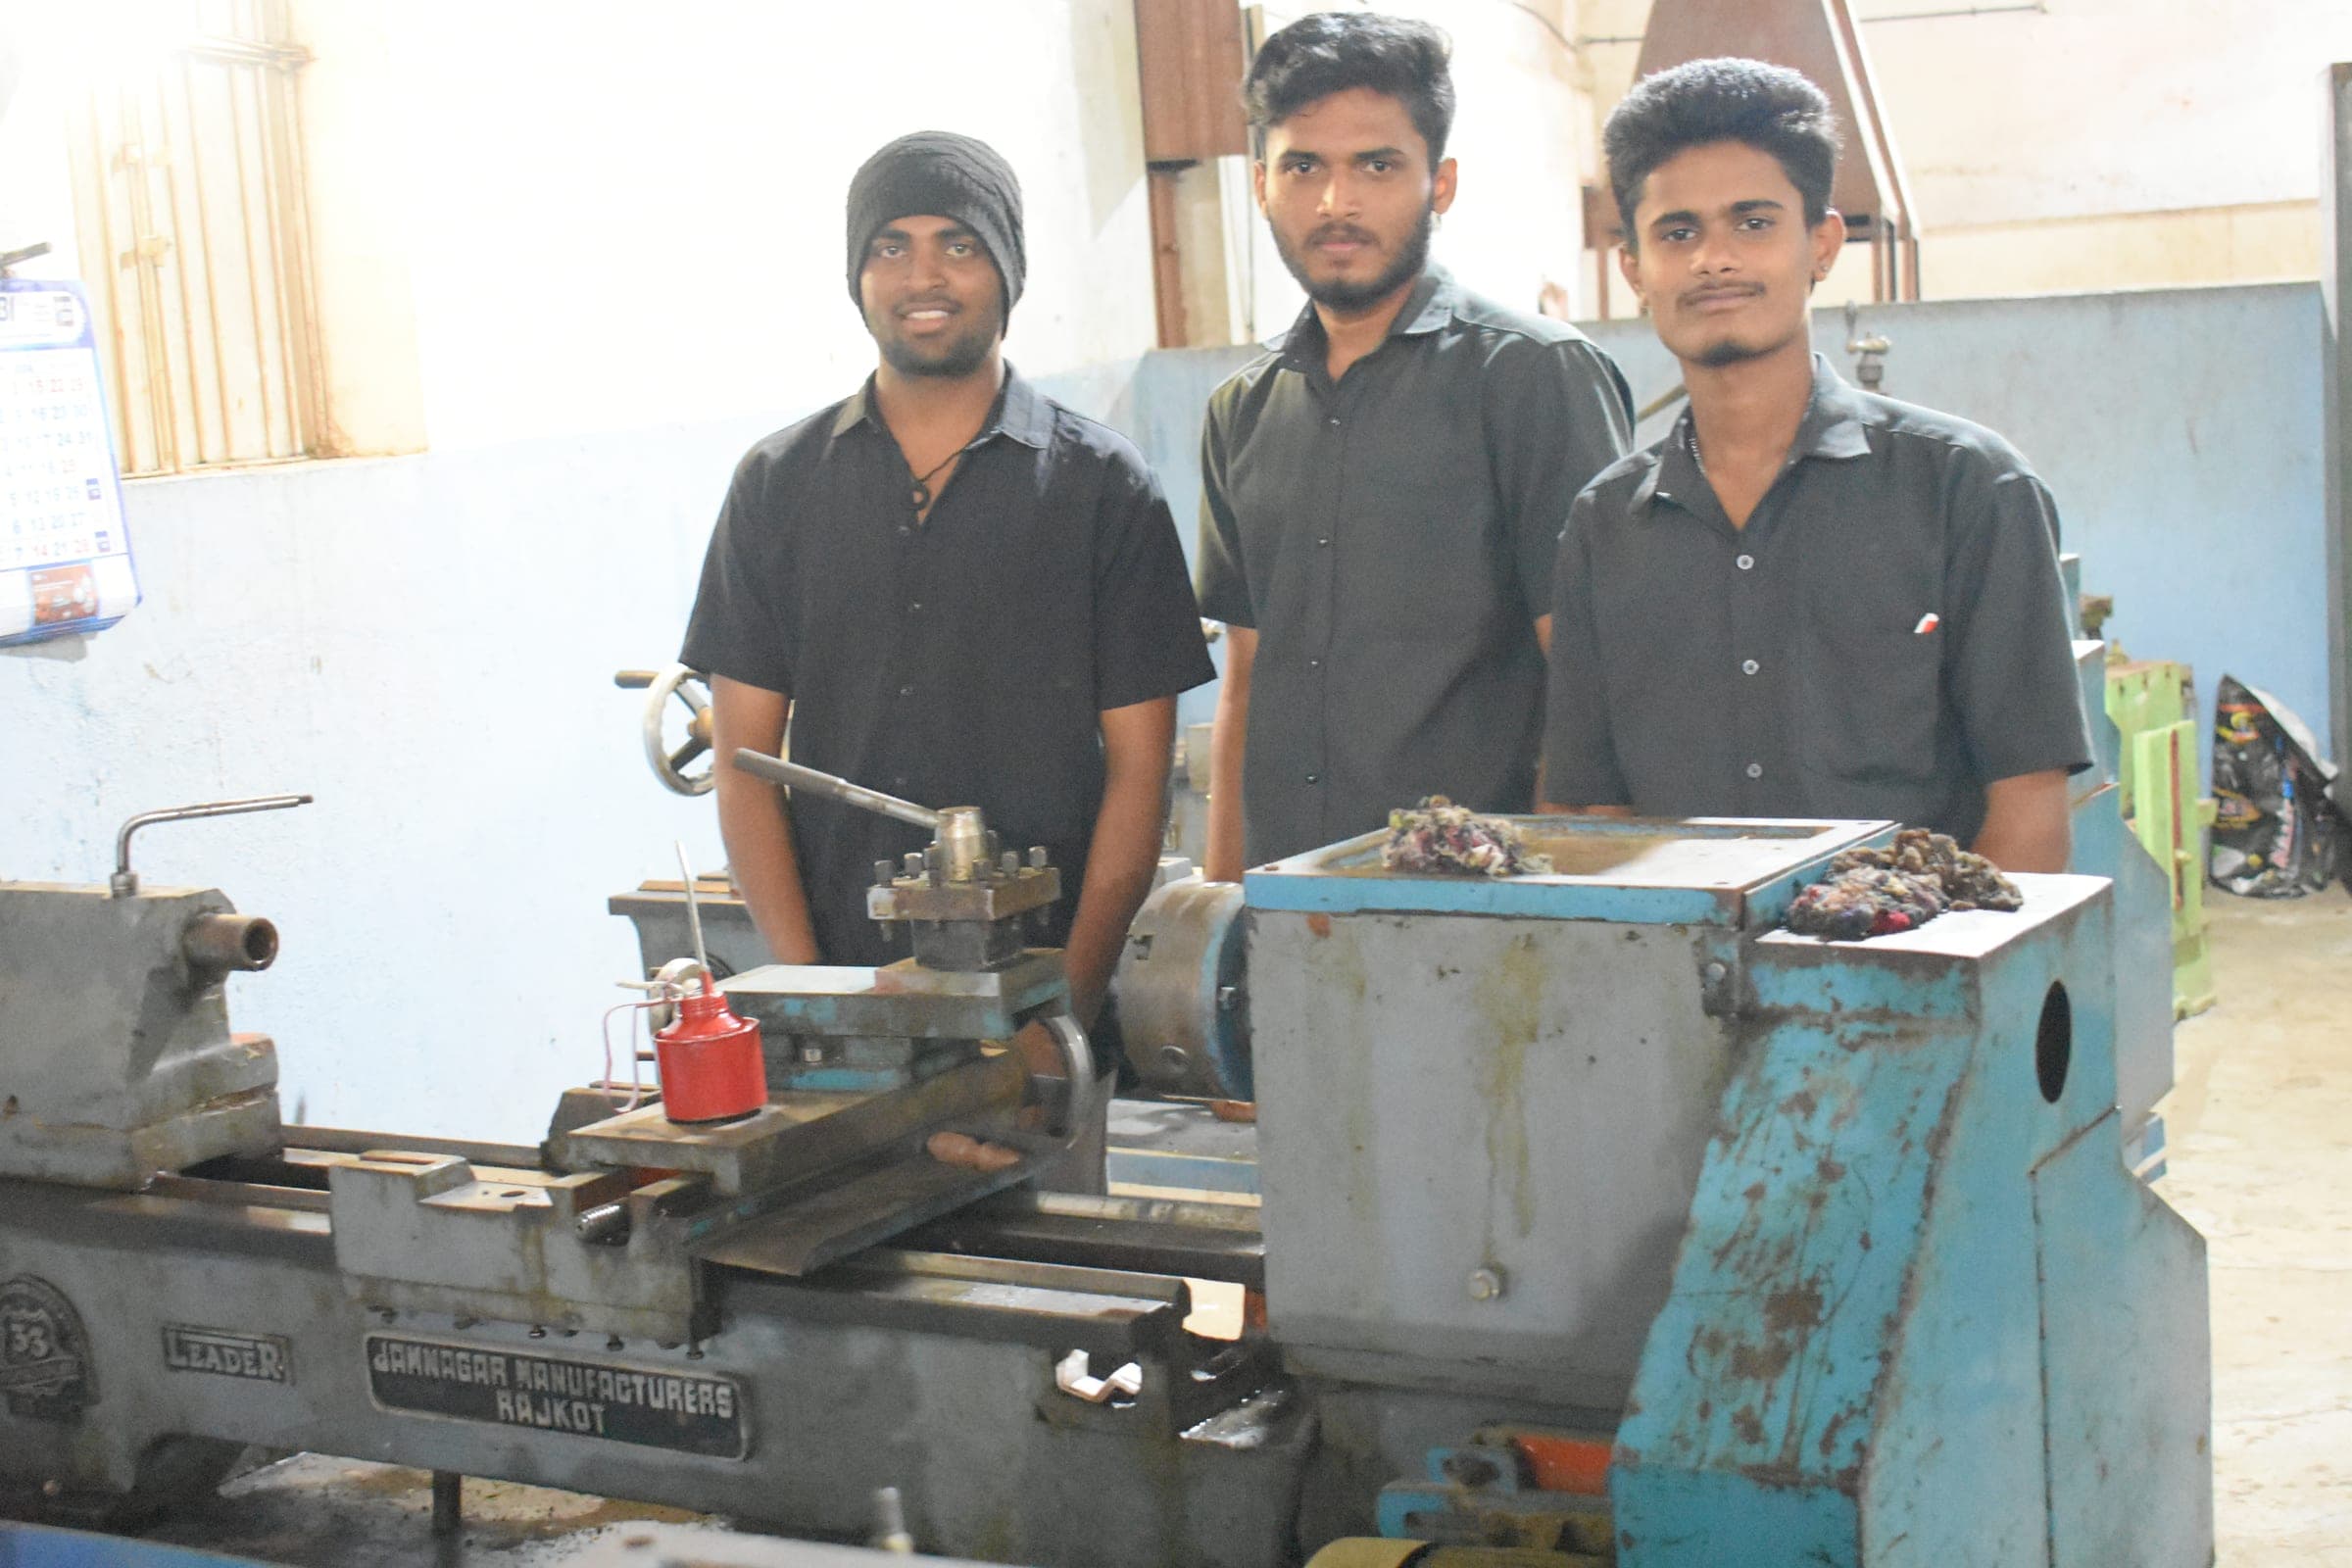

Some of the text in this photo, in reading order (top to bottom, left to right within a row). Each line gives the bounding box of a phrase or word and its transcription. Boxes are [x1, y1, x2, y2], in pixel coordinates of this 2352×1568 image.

[169, 1331, 283, 1380] LEADER
[373, 1341, 734, 1418] JAMNAGAR MANUFACTURERS
[496, 1387, 606, 1435] RAJKOT
